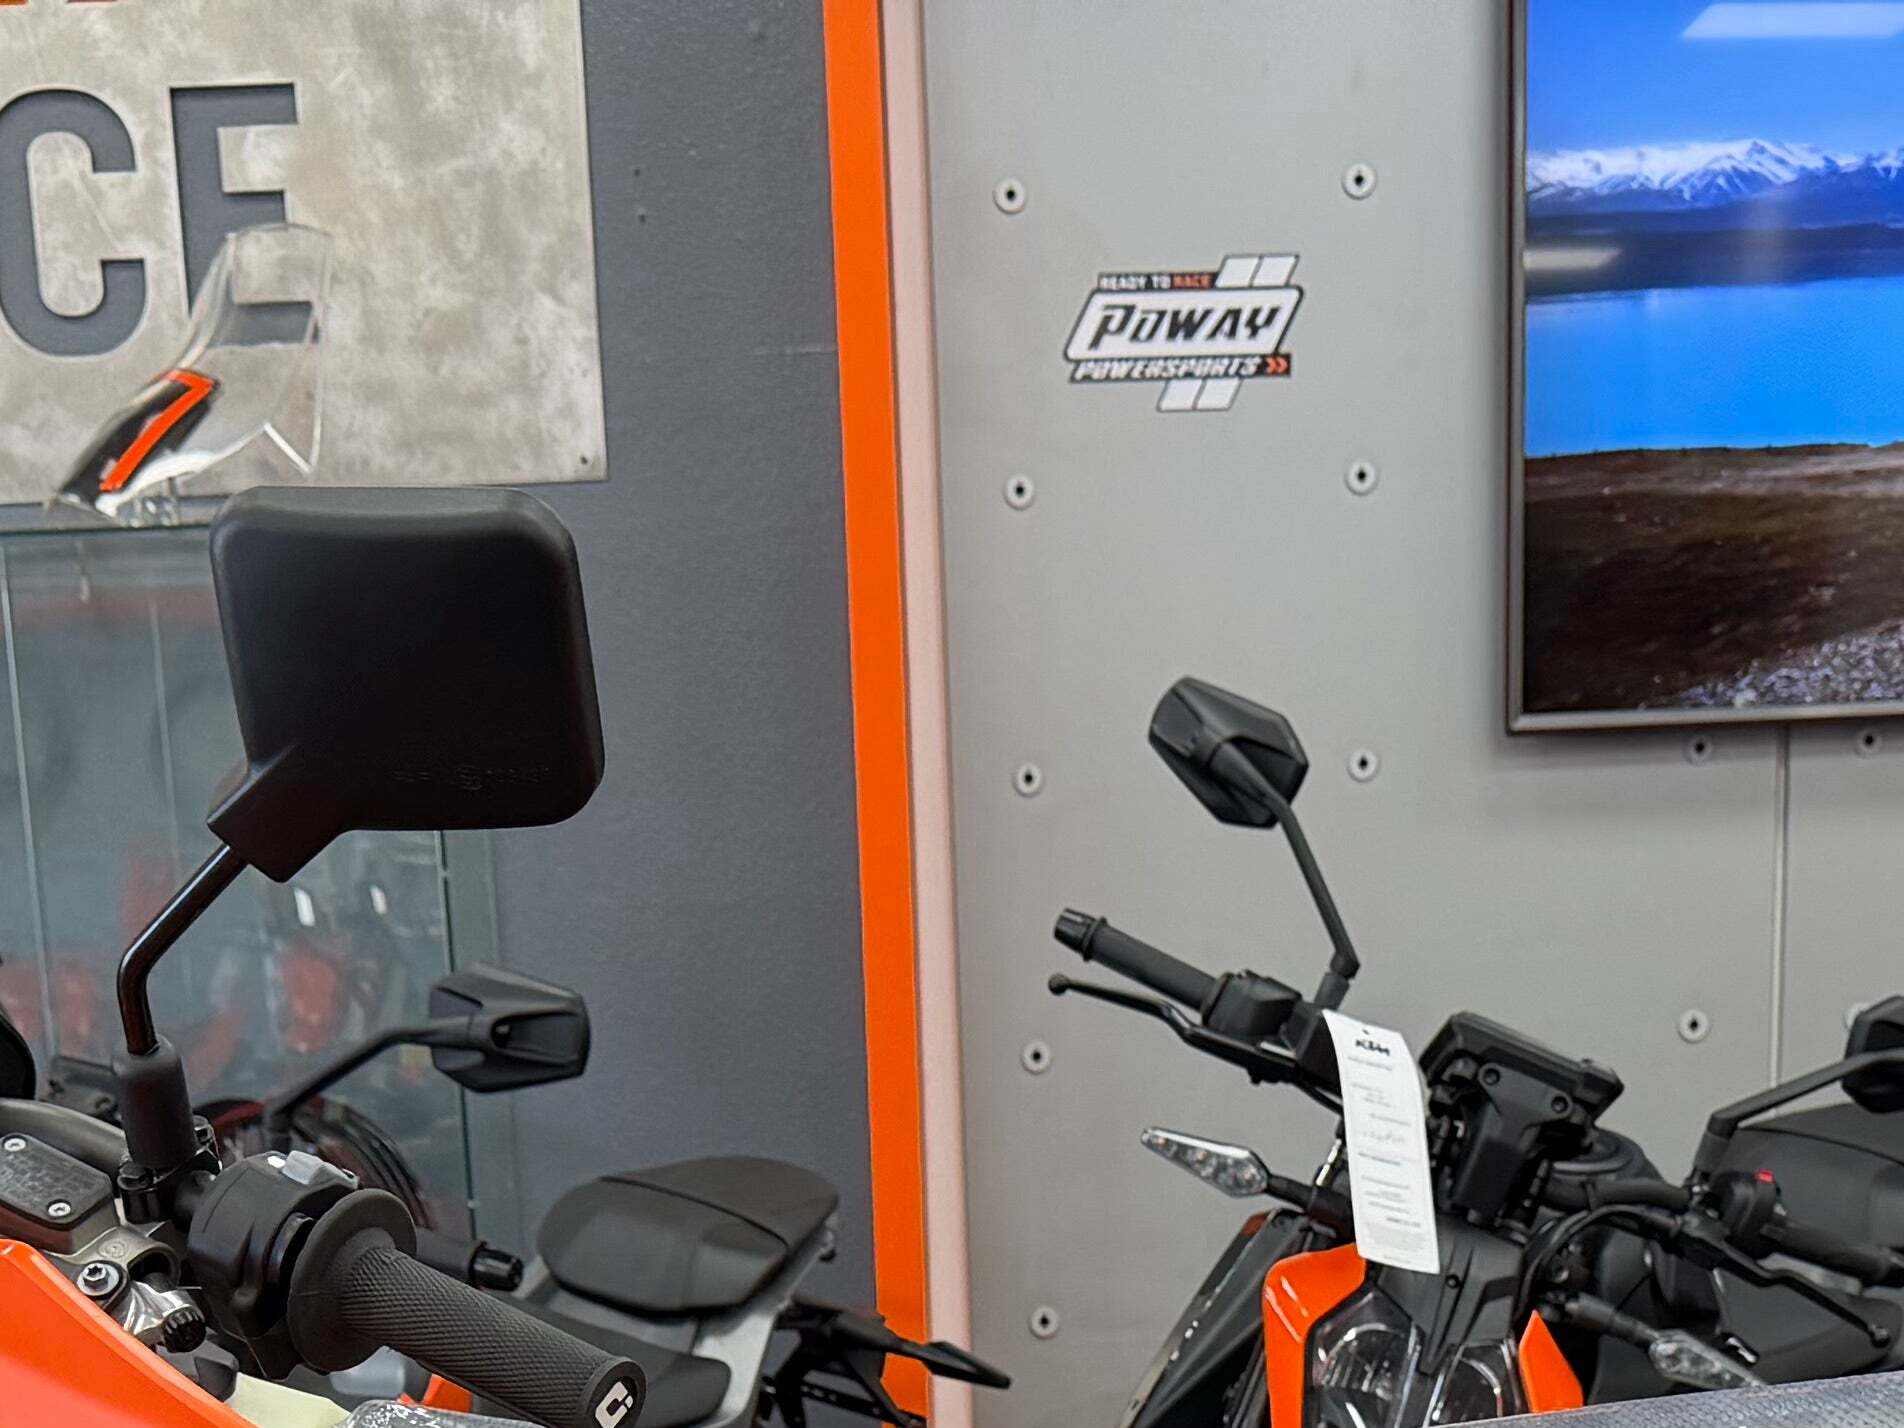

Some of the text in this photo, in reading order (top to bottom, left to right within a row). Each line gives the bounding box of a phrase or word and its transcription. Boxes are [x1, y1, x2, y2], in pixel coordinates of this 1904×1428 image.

[1088, 304, 1282, 350] POWAY
[1074, 356, 1262, 381] POWERSPORTS
[1355, 1039, 1391, 1056] KTM
